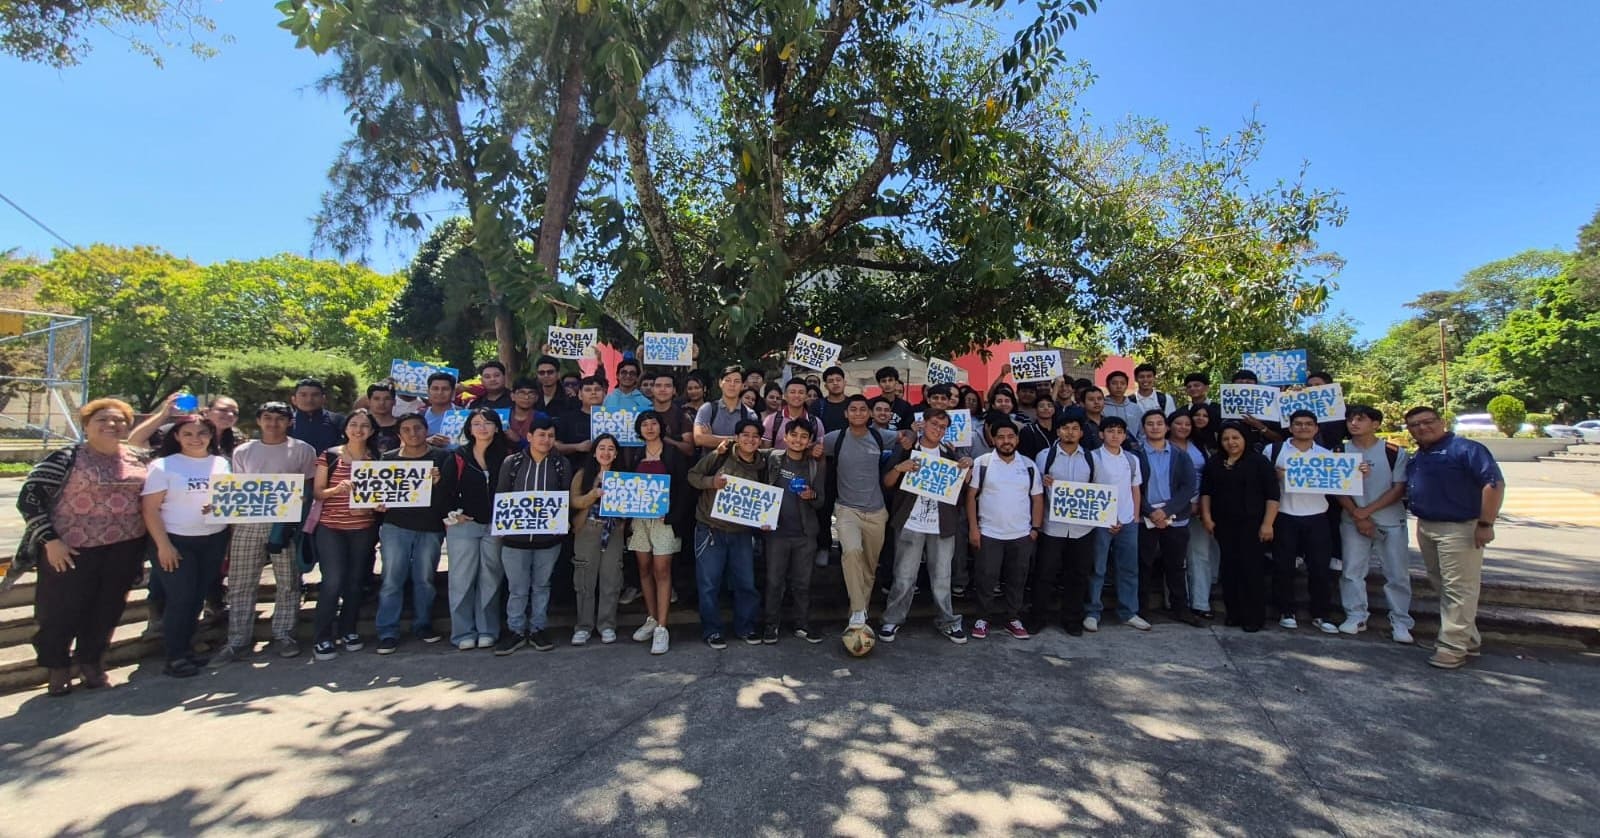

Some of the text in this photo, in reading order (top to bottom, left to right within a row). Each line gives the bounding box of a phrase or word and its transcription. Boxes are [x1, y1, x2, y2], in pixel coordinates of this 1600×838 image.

[550, 339, 591, 348] MONEY
[646, 344, 687, 353] MONEY
[794, 345, 833, 362] MONEY
[1012, 361, 1055, 372] MONEY
[1223, 397, 1273, 407] MONEY
[1223, 405, 1265, 416] WEEK
[353, 467, 431, 480] GLOBAL
[1287, 467, 1353, 479] MONEY
[213, 480, 302, 493] GLOBAL
[353, 479, 423, 491] MONEY
[604, 477, 670, 493] GLOBAL
[1287, 477, 1342, 489] WEEK
[212, 492, 293, 505] MONEY
[353, 491, 410, 504] WEEK
[602, 489, 663, 503] MONEY
[718, 491, 773, 513] MONEY
[211, 504, 278, 517] WEEK
[602, 500, 651, 514] WEEK
[1053, 496, 1110, 512] MONEY
[496, 508, 560, 520] MONEY
[716, 501, 762, 522] WEEK
[1053, 505, 1099, 522] WEEK
[495, 519, 549, 531] WEEK
